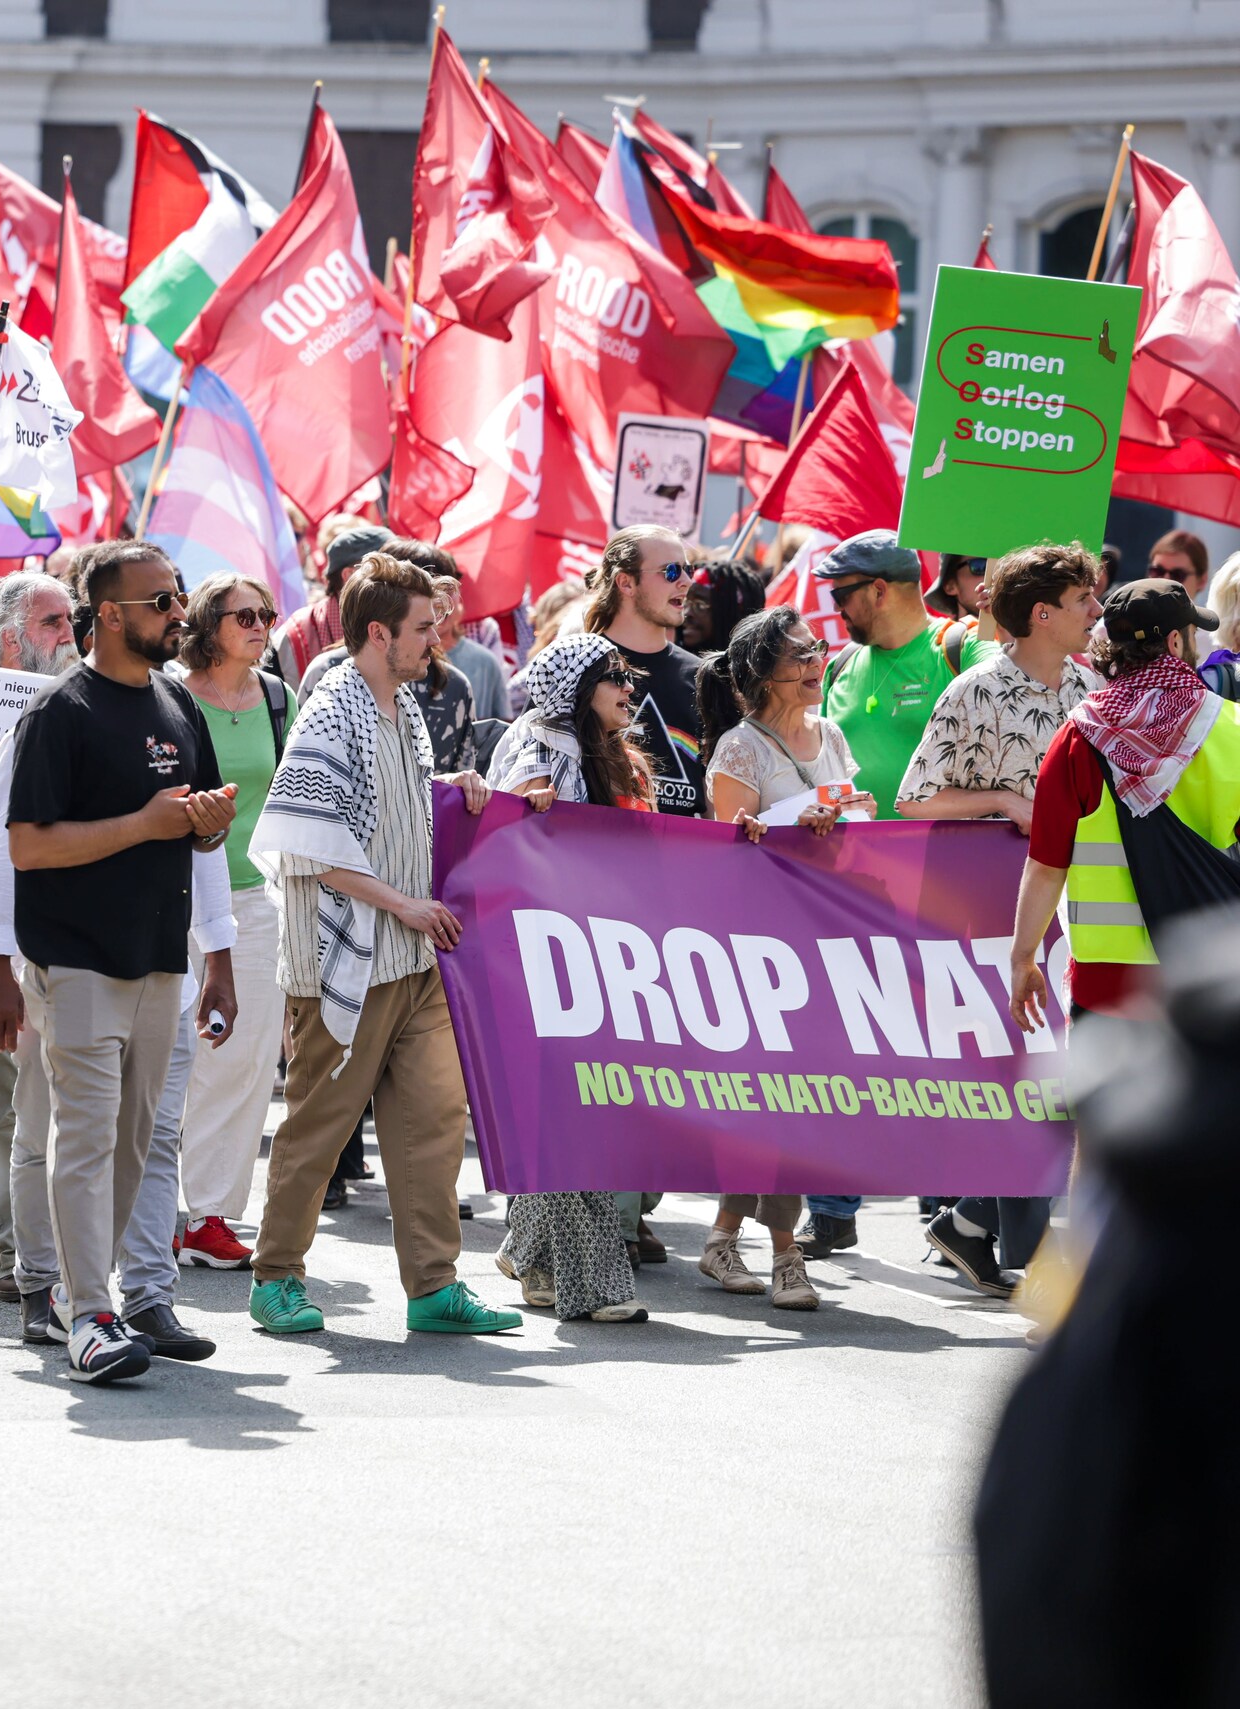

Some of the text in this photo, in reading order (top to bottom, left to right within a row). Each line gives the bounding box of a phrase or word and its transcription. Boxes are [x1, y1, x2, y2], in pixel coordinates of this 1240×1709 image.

[555, 253, 650, 338] ROOD
[964, 342, 1065, 375] Samen
[958, 380, 1066, 419] Oorlog
[953, 417, 1075, 452] Stoppen
[655, 782, 697, 801] LOYD
[661, 798, 674, 806] THE
[511, 908, 810, 1053] DROP
[574, 1062, 634, 1106] NO
[632, 1064, 686, 1109] TO
[683, 1069, 761, 1111] THE
[757, 1073, 1013, 1121] NATO-BACKED
